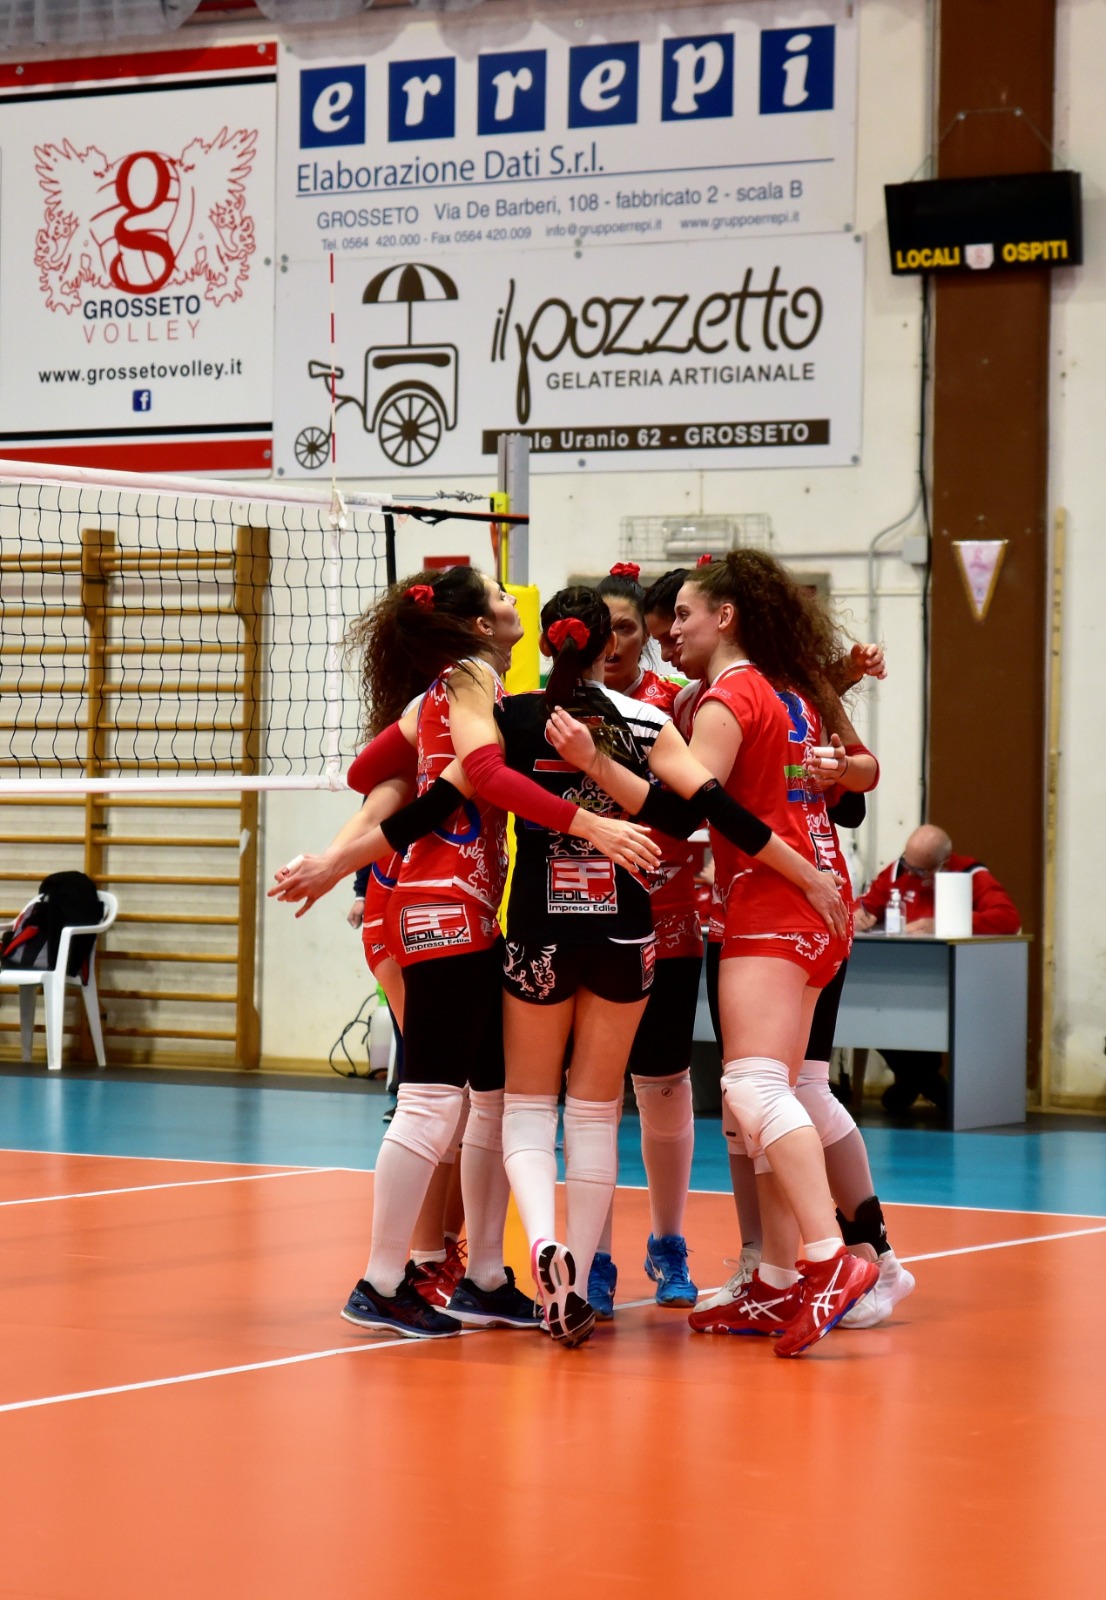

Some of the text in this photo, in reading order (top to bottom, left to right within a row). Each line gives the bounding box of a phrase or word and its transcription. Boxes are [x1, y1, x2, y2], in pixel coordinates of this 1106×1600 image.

[297, 141, 604, 193] Elaborazione Dati S.r.l.
[316, 205, 419, 230] GROSSETO
[434, 202, 461, 220] Via
[467, 200, 490, 219] De
[496, 195, 562, 217] Barberi,
[569, 193, 599, 213] 108
[616, 188, 702, 210] fabbricato
[707, 185, 719, 204] 2
[736, 181, 784, 202] scala
[789, 179, 803, 199] B
[342, 236, 369, 250] 0564
[375, 233, 421, 248] 420.000
[431, 231, 451, 245] Fax
[454, 230, 483, 243] 0564
[486, 226, 532, 241] 420.009
[896, 246, 961, 270] LOCALI
[1002, 239, 1069, 263] OSPITI
[83, 294, 202, 320] GROSSETO
[83, 318, 201, 344] VOLLEY
[490, 265, 824, 426] il pozzetto
[38, 358, 243, 385] www.grossetovolley.it
[545, 362, 816, 391] GELATERIA ARTIGIANALE
[560, 429, 628, 449] Uranio
[637, 428, 662, 447] 62
[684, 423, 810, 445] GROSSETO
[549, 904, 616, 912] Impresa Edile
[406, 941, 445, 953] Impresa
